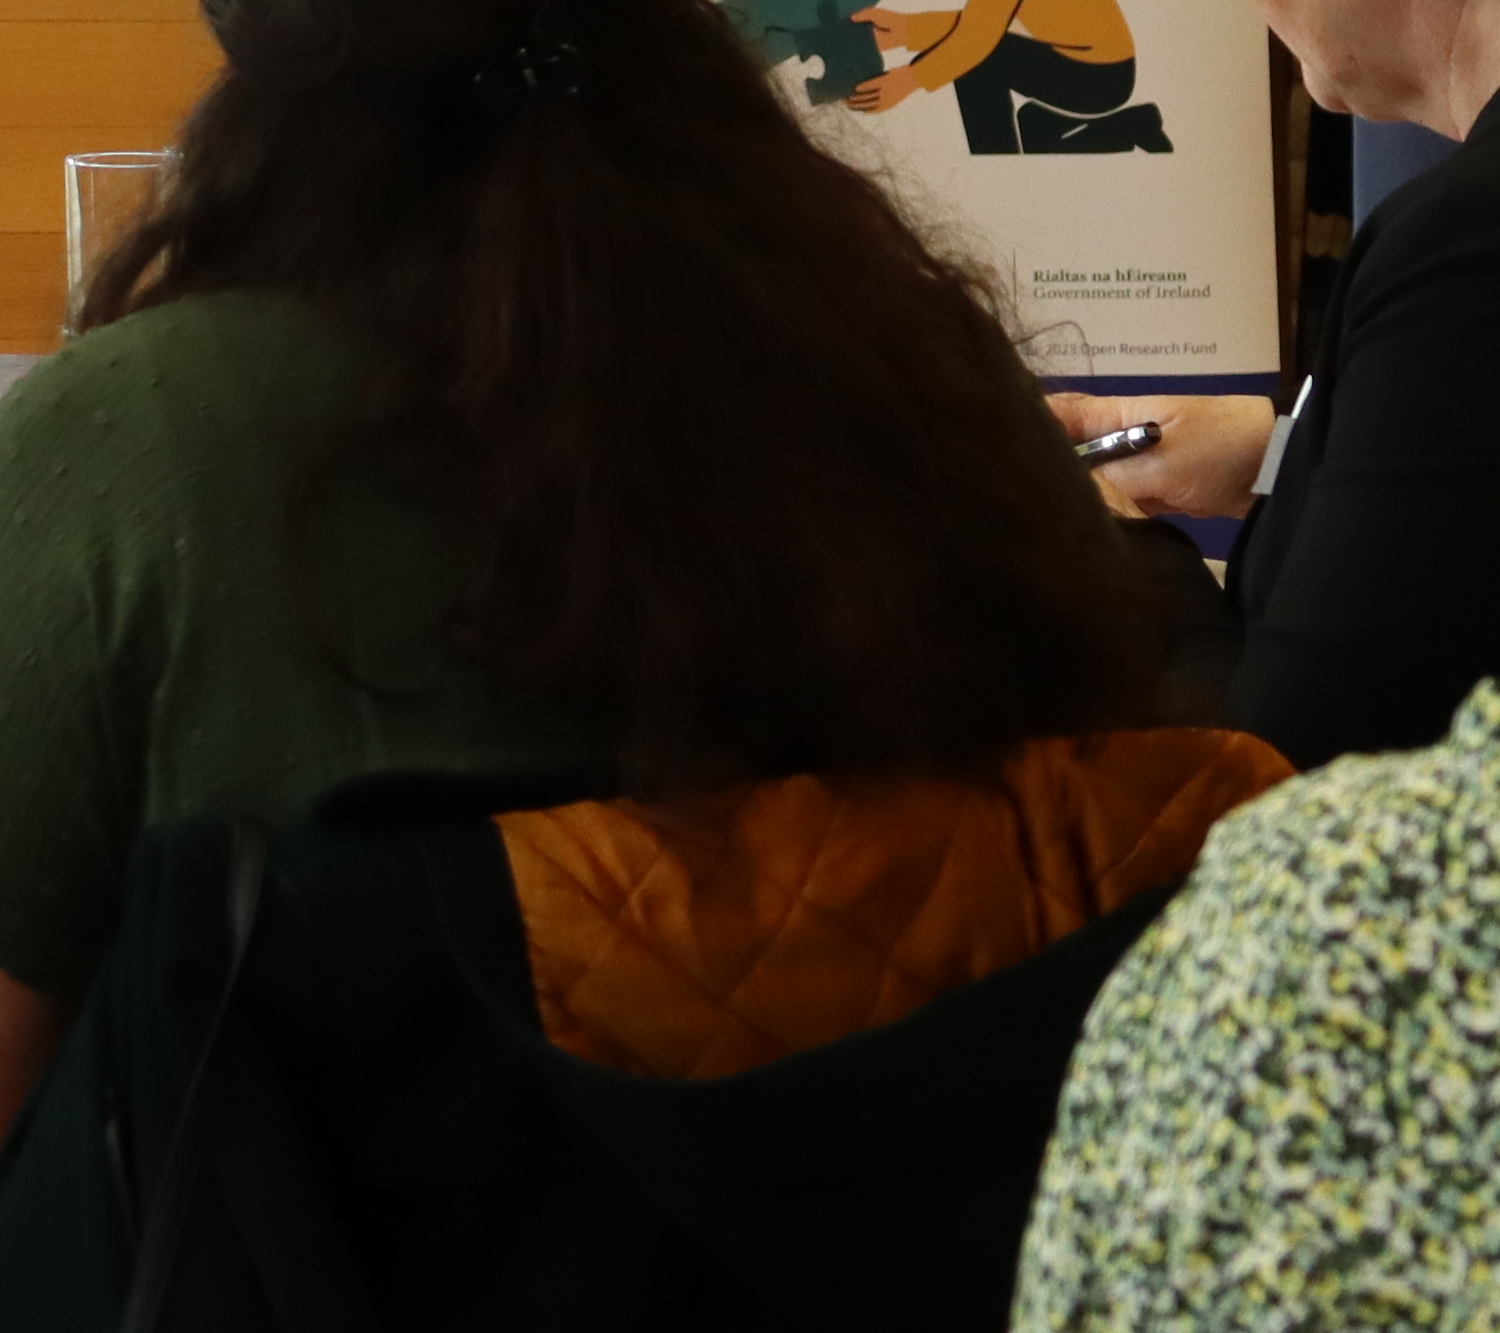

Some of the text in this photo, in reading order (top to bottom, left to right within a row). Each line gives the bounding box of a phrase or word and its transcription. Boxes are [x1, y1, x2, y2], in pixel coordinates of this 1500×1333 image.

[1033, 269, 1087, 283] Rialtas
[1092, 272, 1111, 283] na
[1033, 285, 1212, 300] Government of Ireland
[1045, 343, 1077, 356] 2023
[1081, 343, 1117, 358] Open
[1119, 342, 1181, 356] Research
[1183, 341, 1217, 354] Fund
